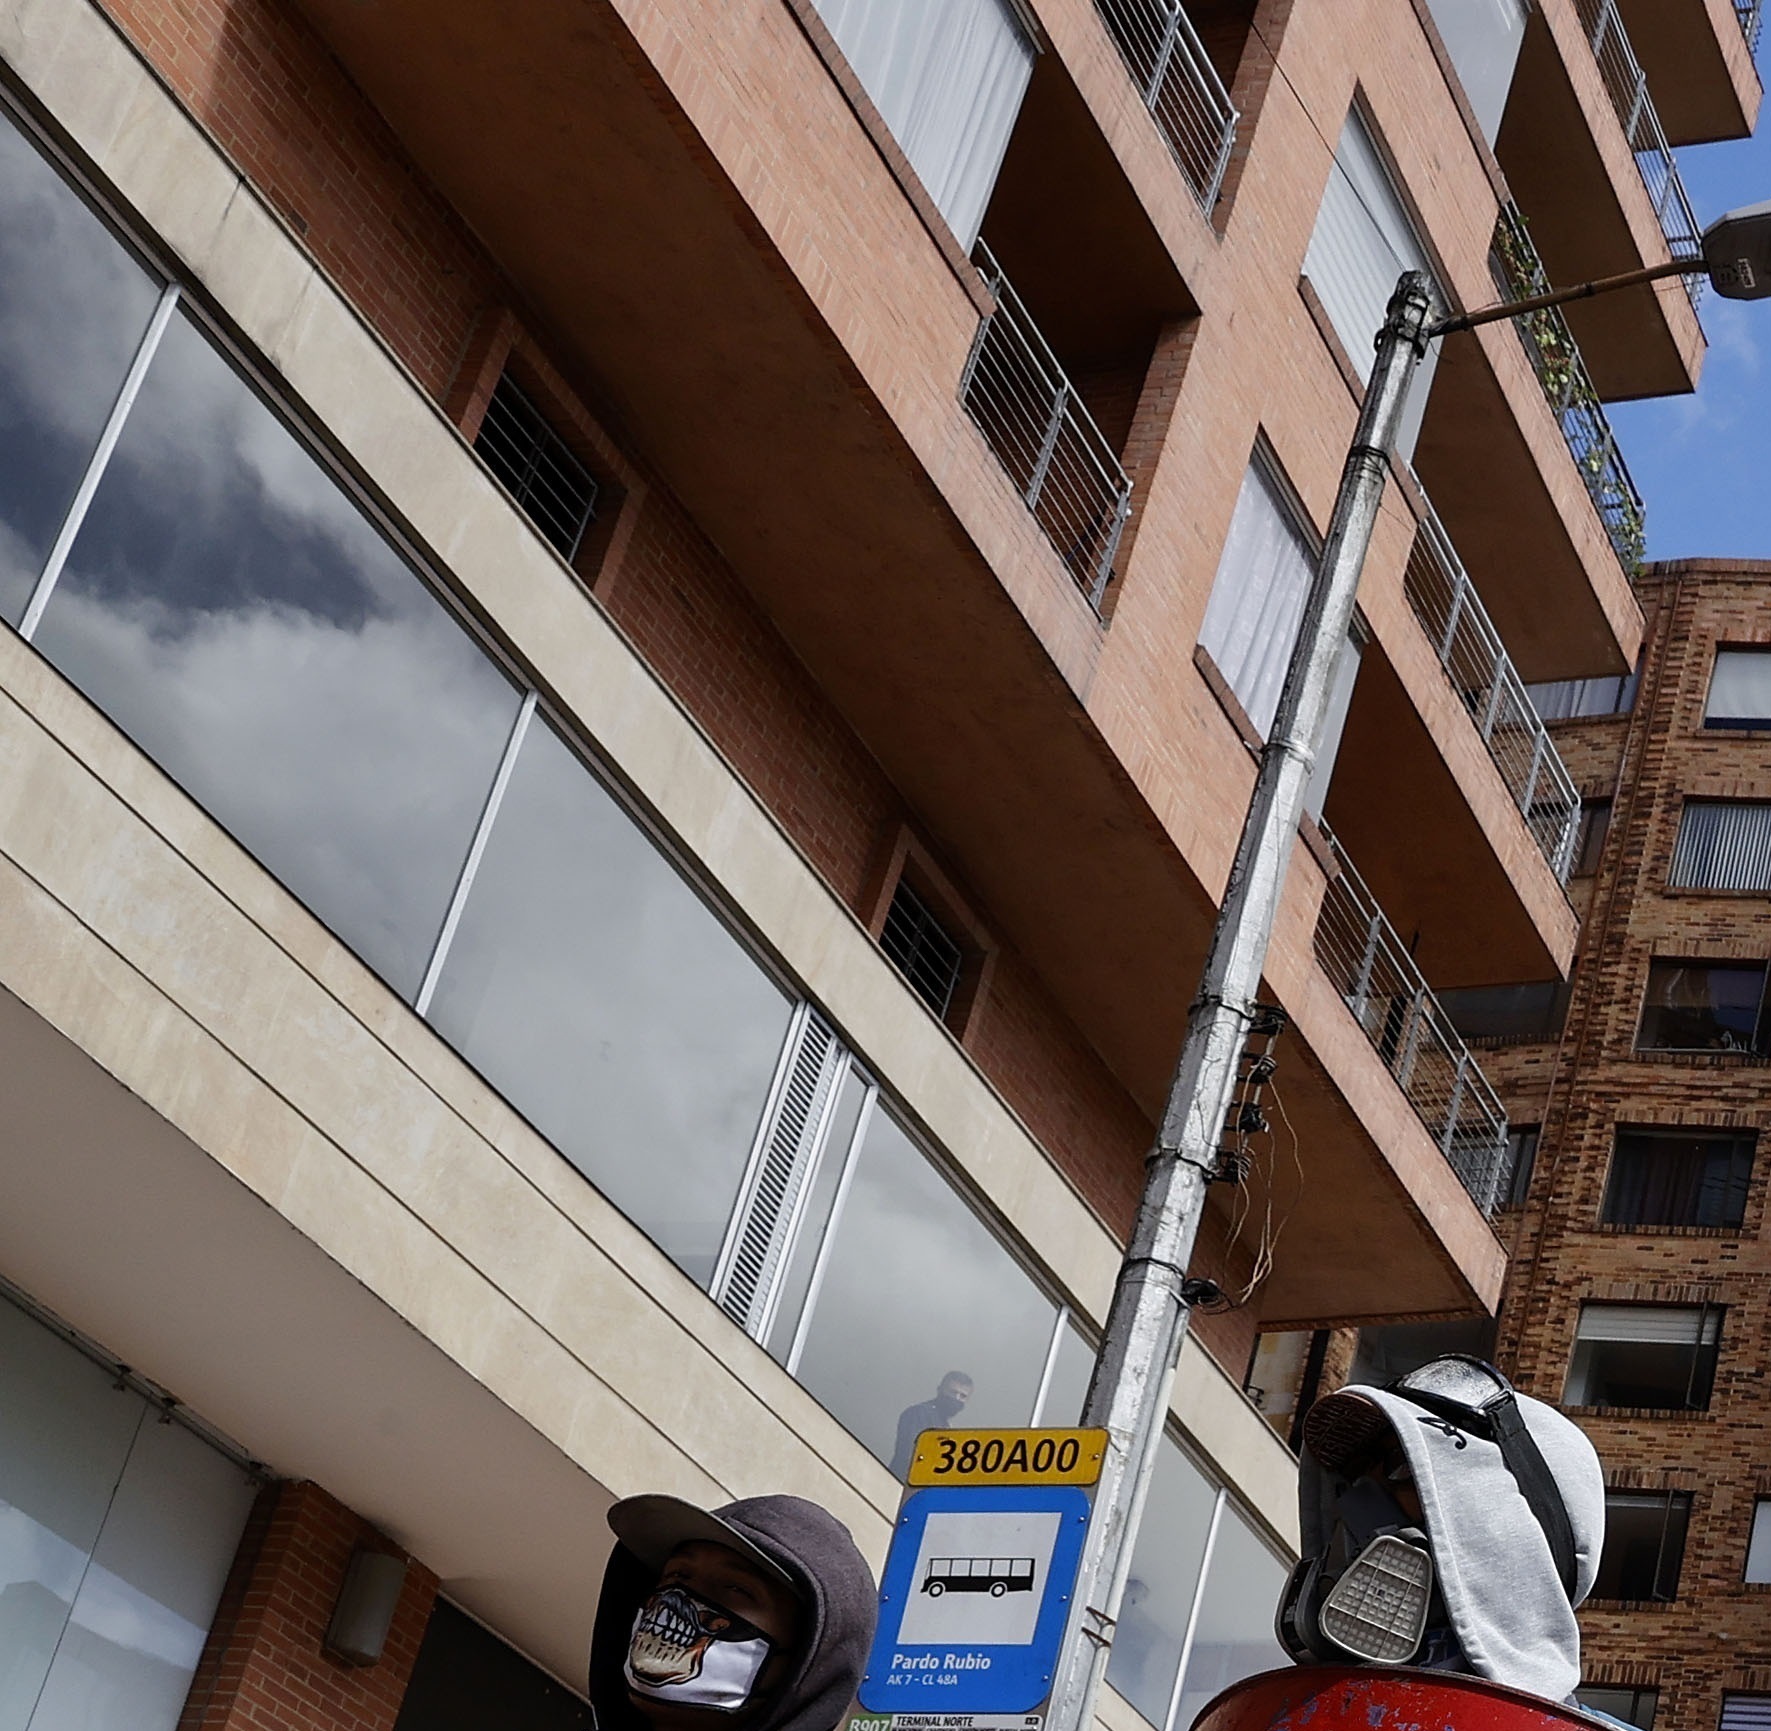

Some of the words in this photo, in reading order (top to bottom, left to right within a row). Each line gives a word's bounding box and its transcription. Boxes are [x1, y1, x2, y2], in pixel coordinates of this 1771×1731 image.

[933, 1438, 1080, 1475] 380A00
[891, 1653, 939, 1670] Pardo
[943, 1653, 992, 1670] Rubio
[886, 1674, 903, 1686] AK
[905, 1674, 912, 1686] 7
[922, 1674, 935, 1686] CL
[937, 1674, 958, 1686] 48A
[896, 1716, 941, 1727] TERMINAL
[942, 1716, 974, 1727] NORTE
